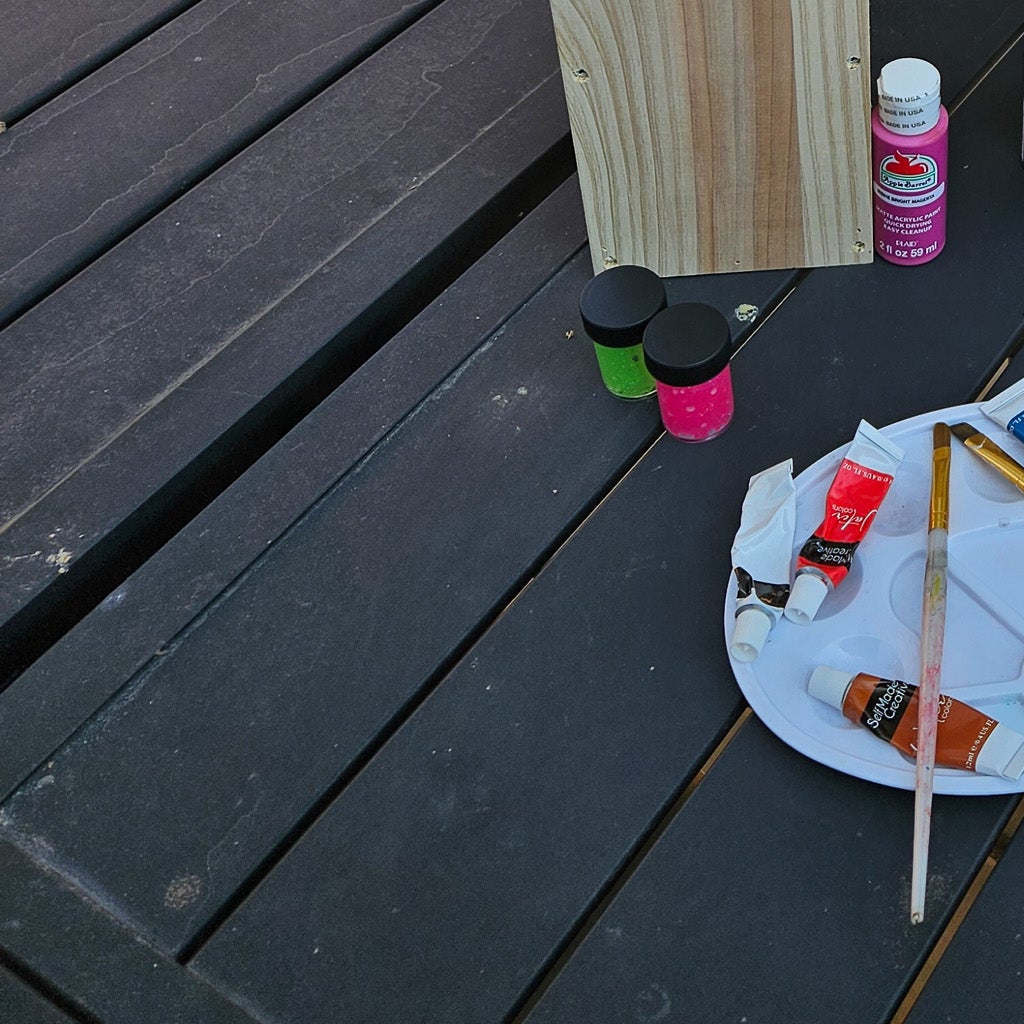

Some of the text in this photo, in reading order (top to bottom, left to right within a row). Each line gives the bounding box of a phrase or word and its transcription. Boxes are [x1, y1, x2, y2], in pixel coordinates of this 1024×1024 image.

[904, 95, 921, 103] USA
[907, 108, 924, 116] USA
[911, 120, 926, 128] USA
[895, 215, 923, 223] ACRYLIC
[925, 206, 941, 219] PAINT
[883, 218, 932, 229] QUICK DRYING
[883, 223, 932, 235] EASY CLEANUP
[879, 240, 937, 257] 2 fl oz 59 ml
[867, 679, 899, 729] Self Made
[884, 682, 908, 719] Creativ
